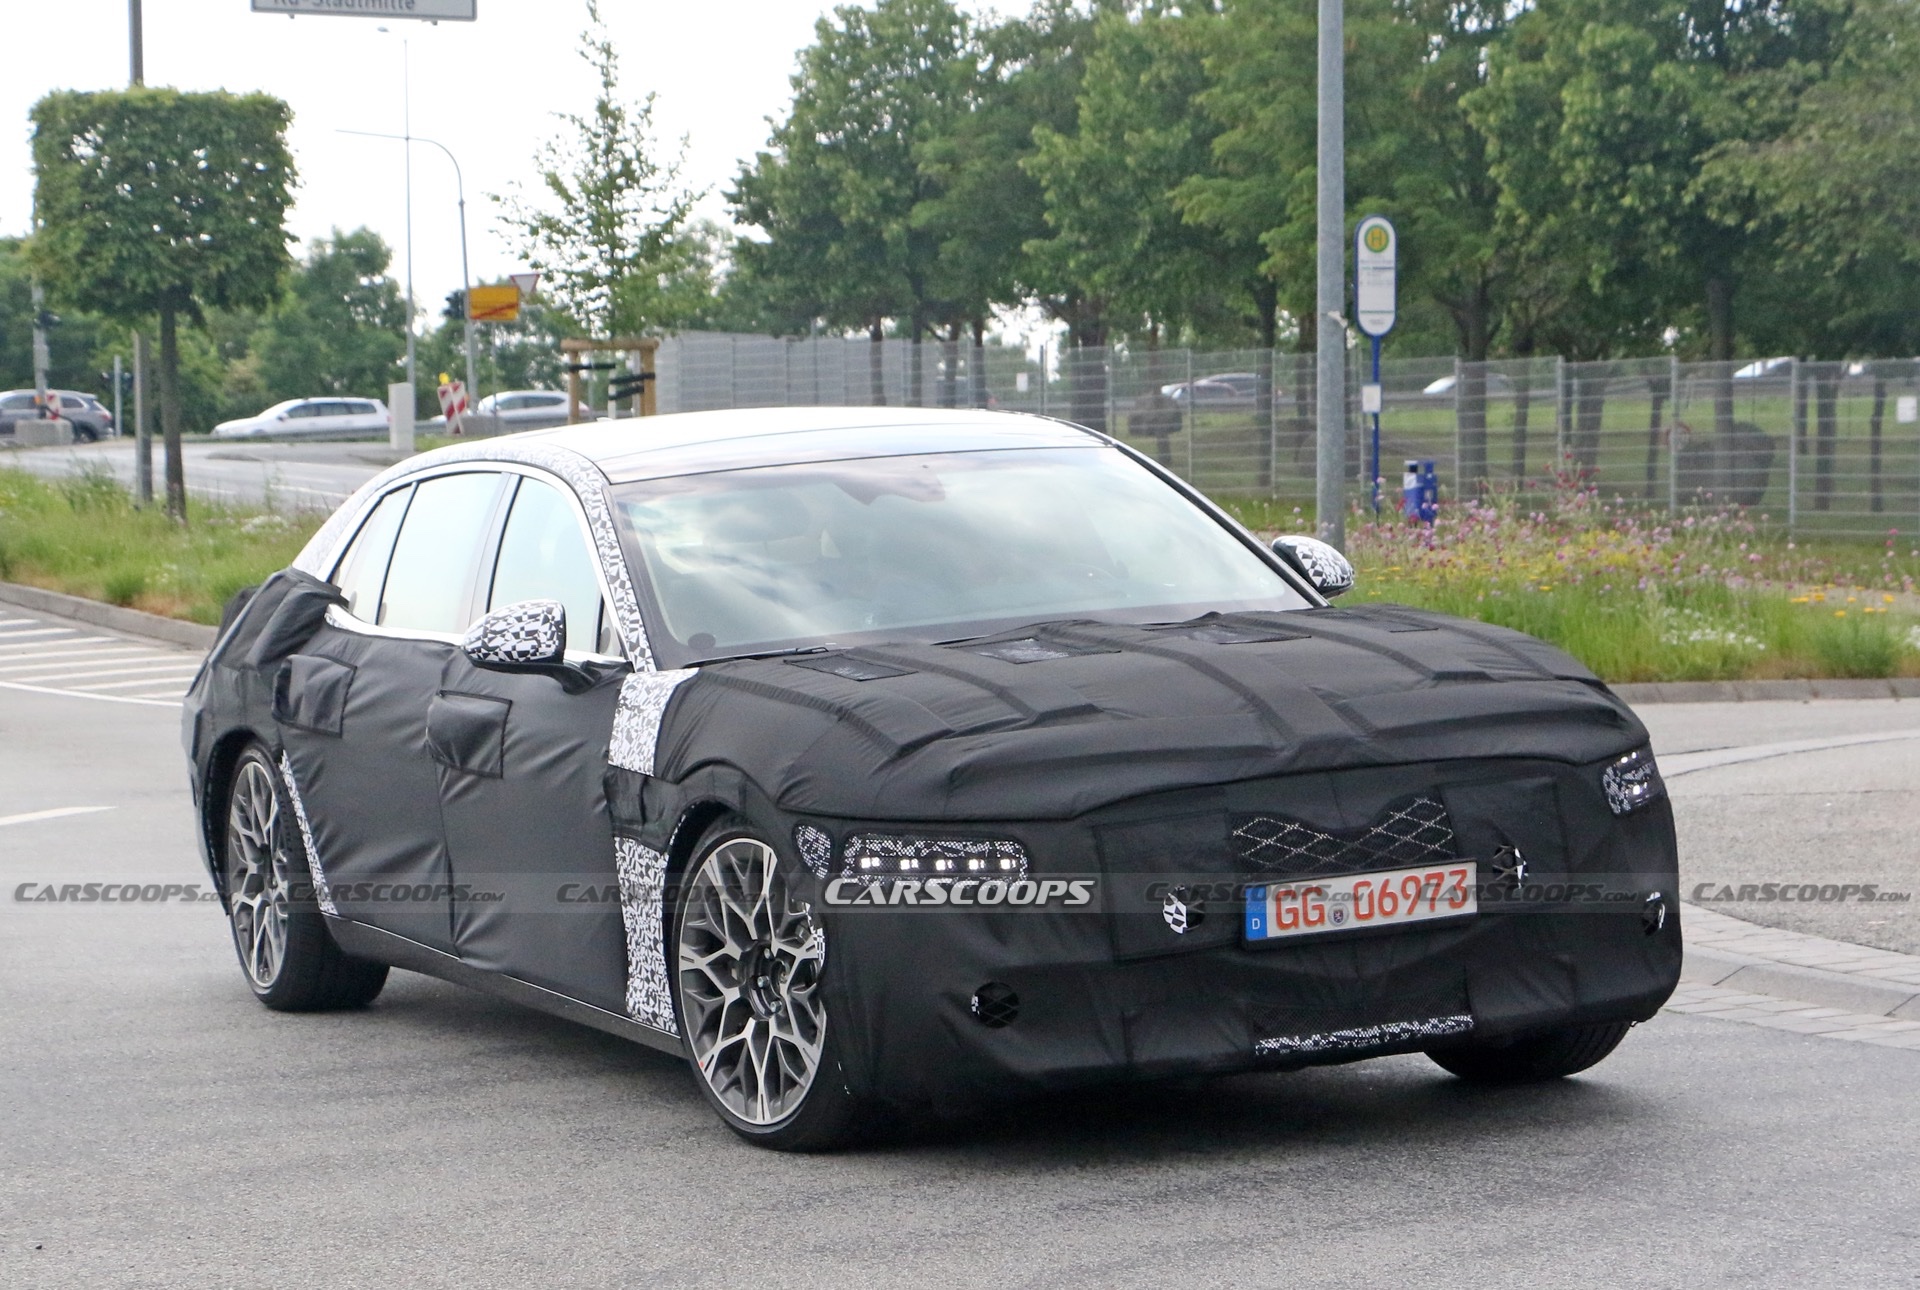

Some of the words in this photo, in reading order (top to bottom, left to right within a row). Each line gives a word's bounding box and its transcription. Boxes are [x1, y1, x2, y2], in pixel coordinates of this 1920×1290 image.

[1252, 918, 1260, 930] D
[1275, 886, 1327, 930] GG
[1353, 869, 1468, 921] 06973
